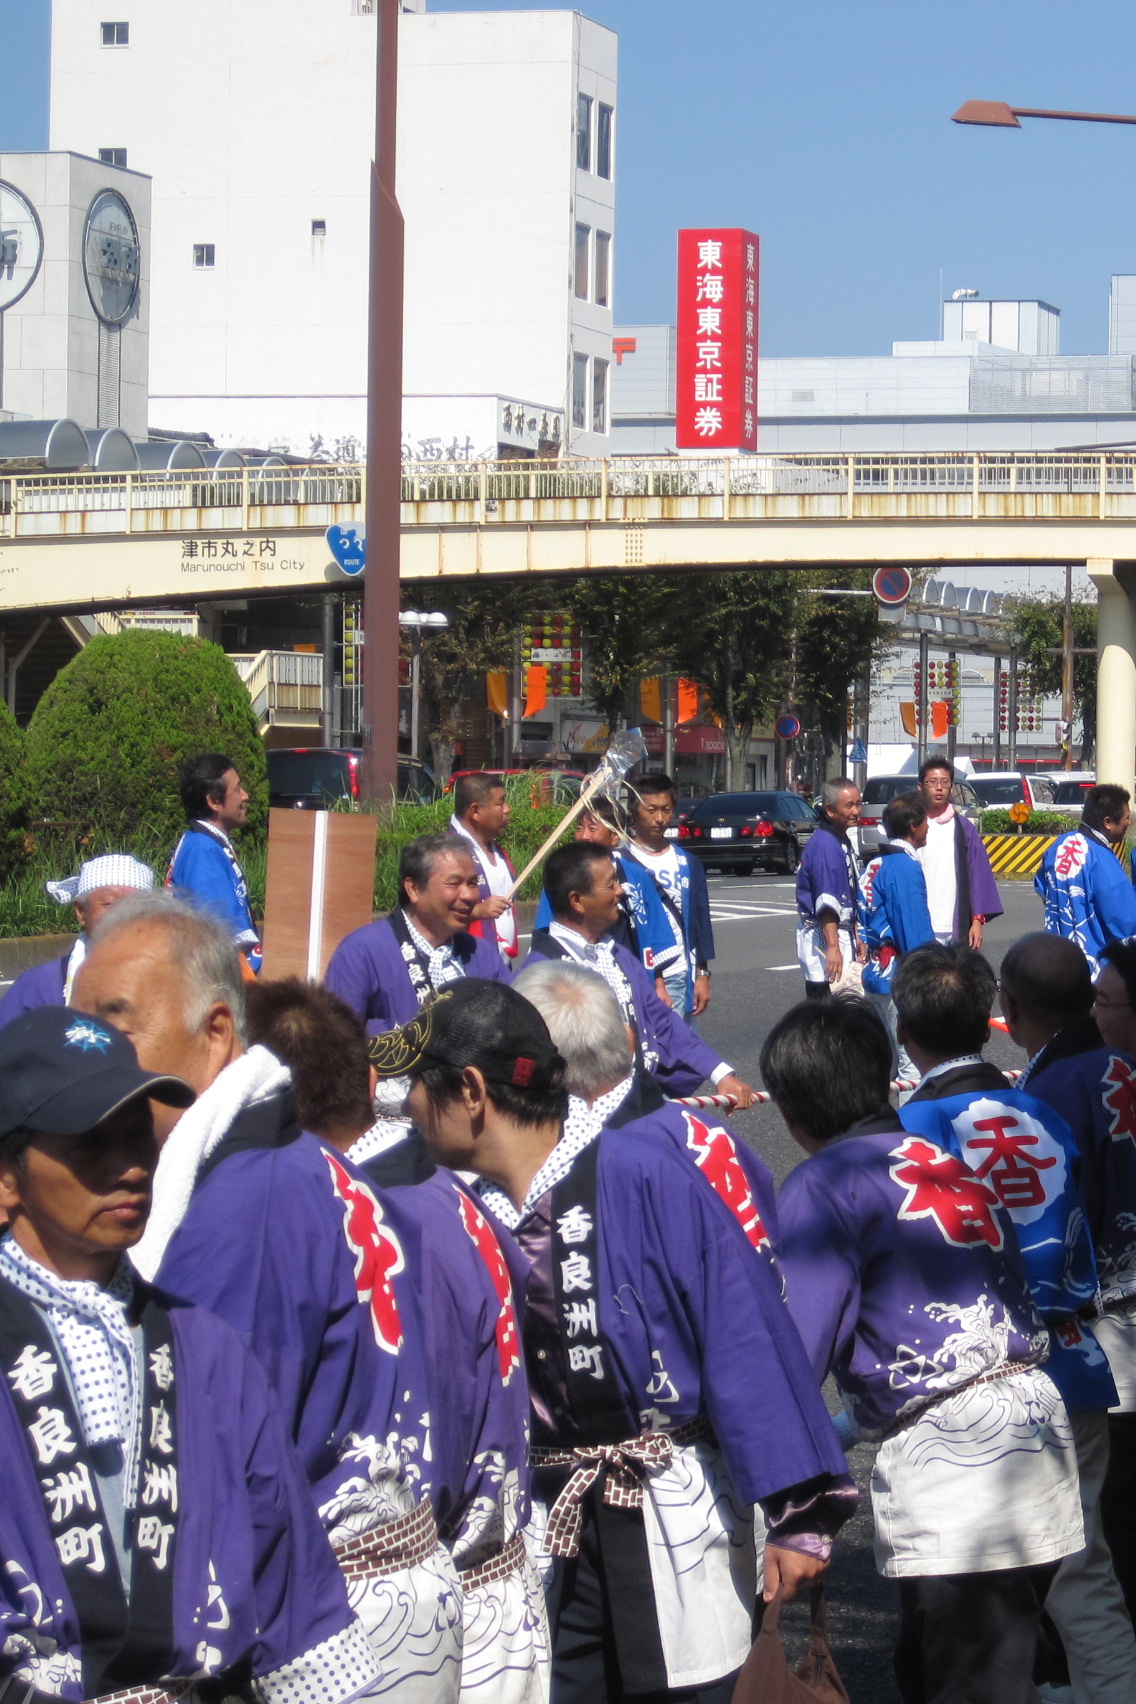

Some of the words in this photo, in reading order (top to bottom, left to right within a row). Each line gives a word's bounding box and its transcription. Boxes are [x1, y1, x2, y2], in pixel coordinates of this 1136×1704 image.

[694, 238, 724, 437] 東海東京証券
[744, 242, 755, 438] 東海東京証券
[181, 538, 277, 559] 津市丸之内
[181, 561, 245, 573] Marunouchi
[252, 560, 274, 571] Tsu
[280, 559, 305, 572] City
[343, 558, 361, 567] ROUTE
[1056, 840, 1084, 876] 香
[887, 1136, 1003, 1252] 香
[966, 1115, 1057, 1209] 香
[556, 1205, 605, 1380] 香良洲町
[7, 1344, 106, 1573] 香良洲町
[137, 1343, 179, 1570] 香良洲町
